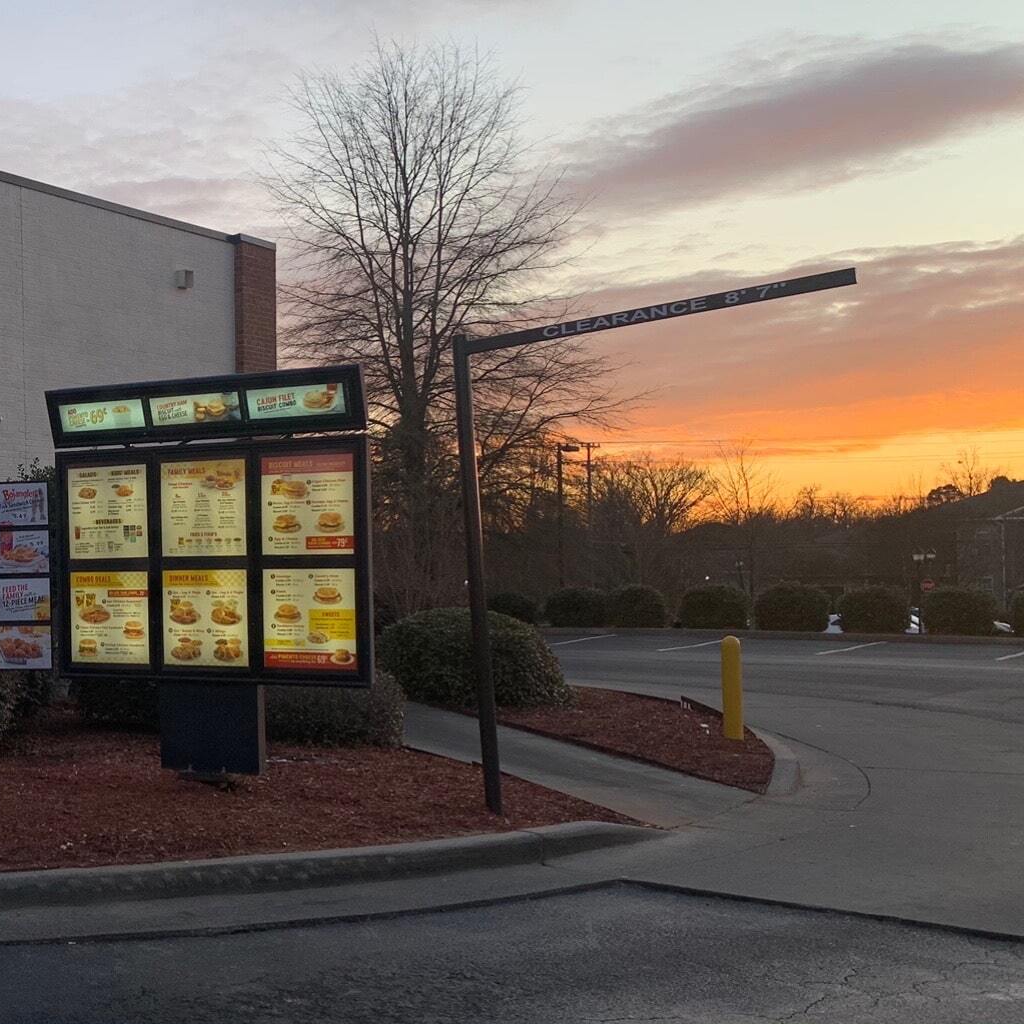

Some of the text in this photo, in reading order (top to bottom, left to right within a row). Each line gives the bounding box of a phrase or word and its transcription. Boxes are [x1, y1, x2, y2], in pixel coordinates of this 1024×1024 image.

[542, 298, 708, 338] CLEARANCE
[724, 289, 747, 305] 8'
[257, 393, 295, 406] CAJUN FILET
[278, 400, 296, 409] COMBO
[190, 574, 209, 582] MEALS
